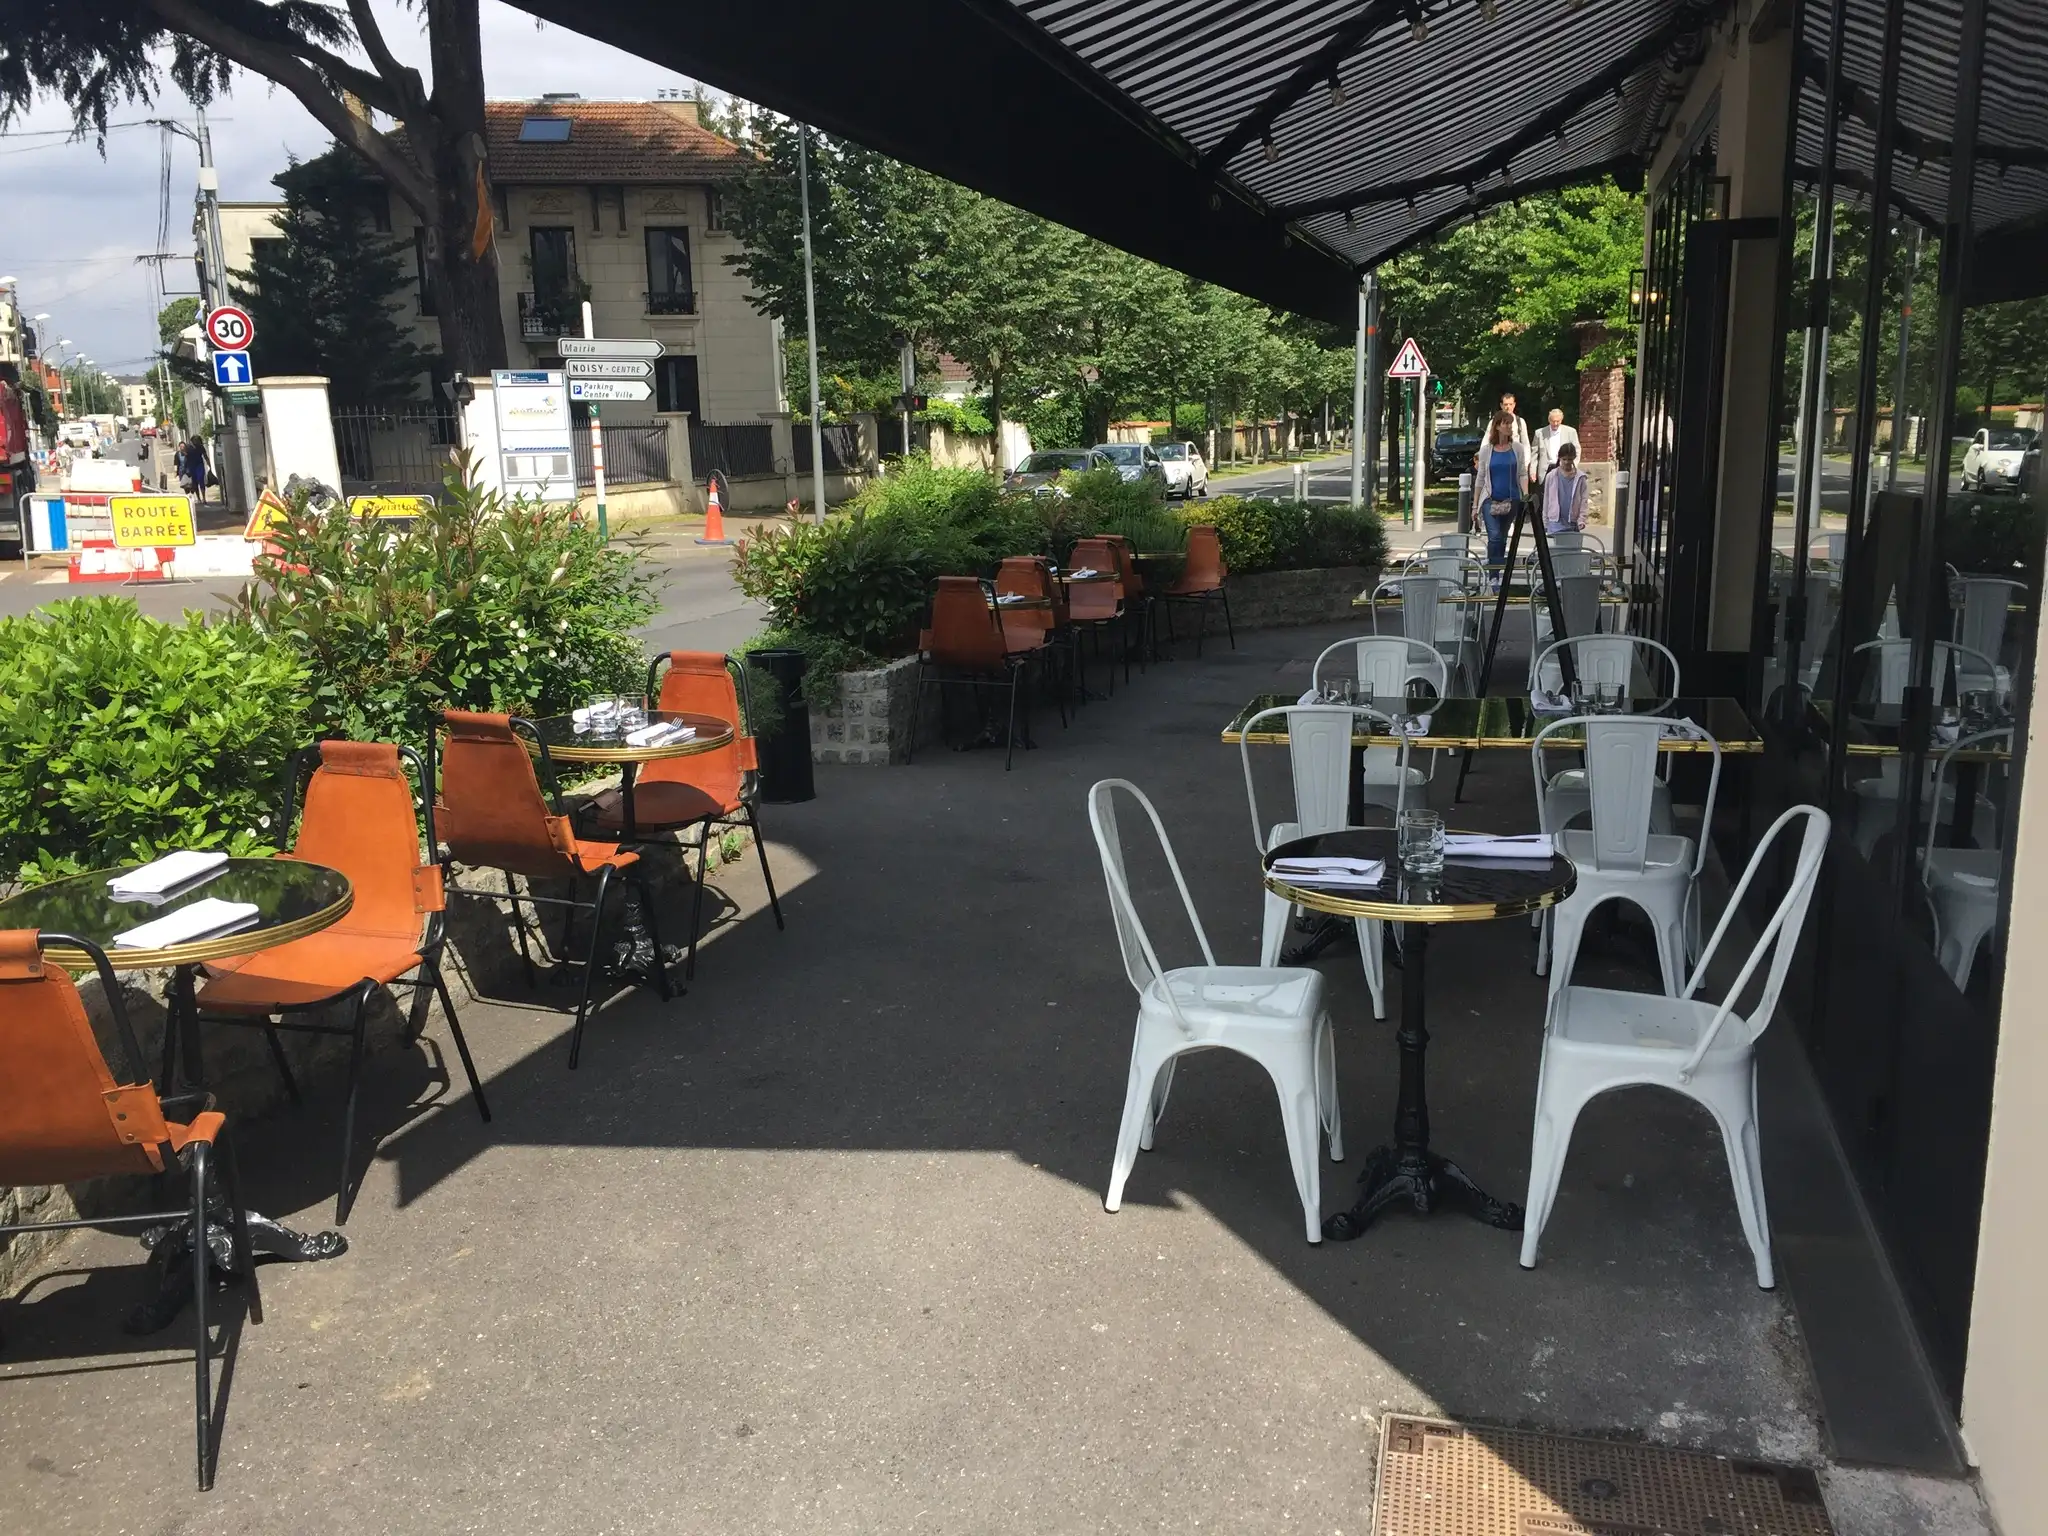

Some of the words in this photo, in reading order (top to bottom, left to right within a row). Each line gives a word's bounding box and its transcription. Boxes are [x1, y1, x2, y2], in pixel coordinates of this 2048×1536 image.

[217, 319, 245, 338] 30
[564, 343, 596, 352] Mairie
[572, 364, 604, 373] NOISY
[583, 382, 614, 391] Parking
[123, 506, 179, 518] ROUTE
[121, 522, 188, 538] BARRÉE
